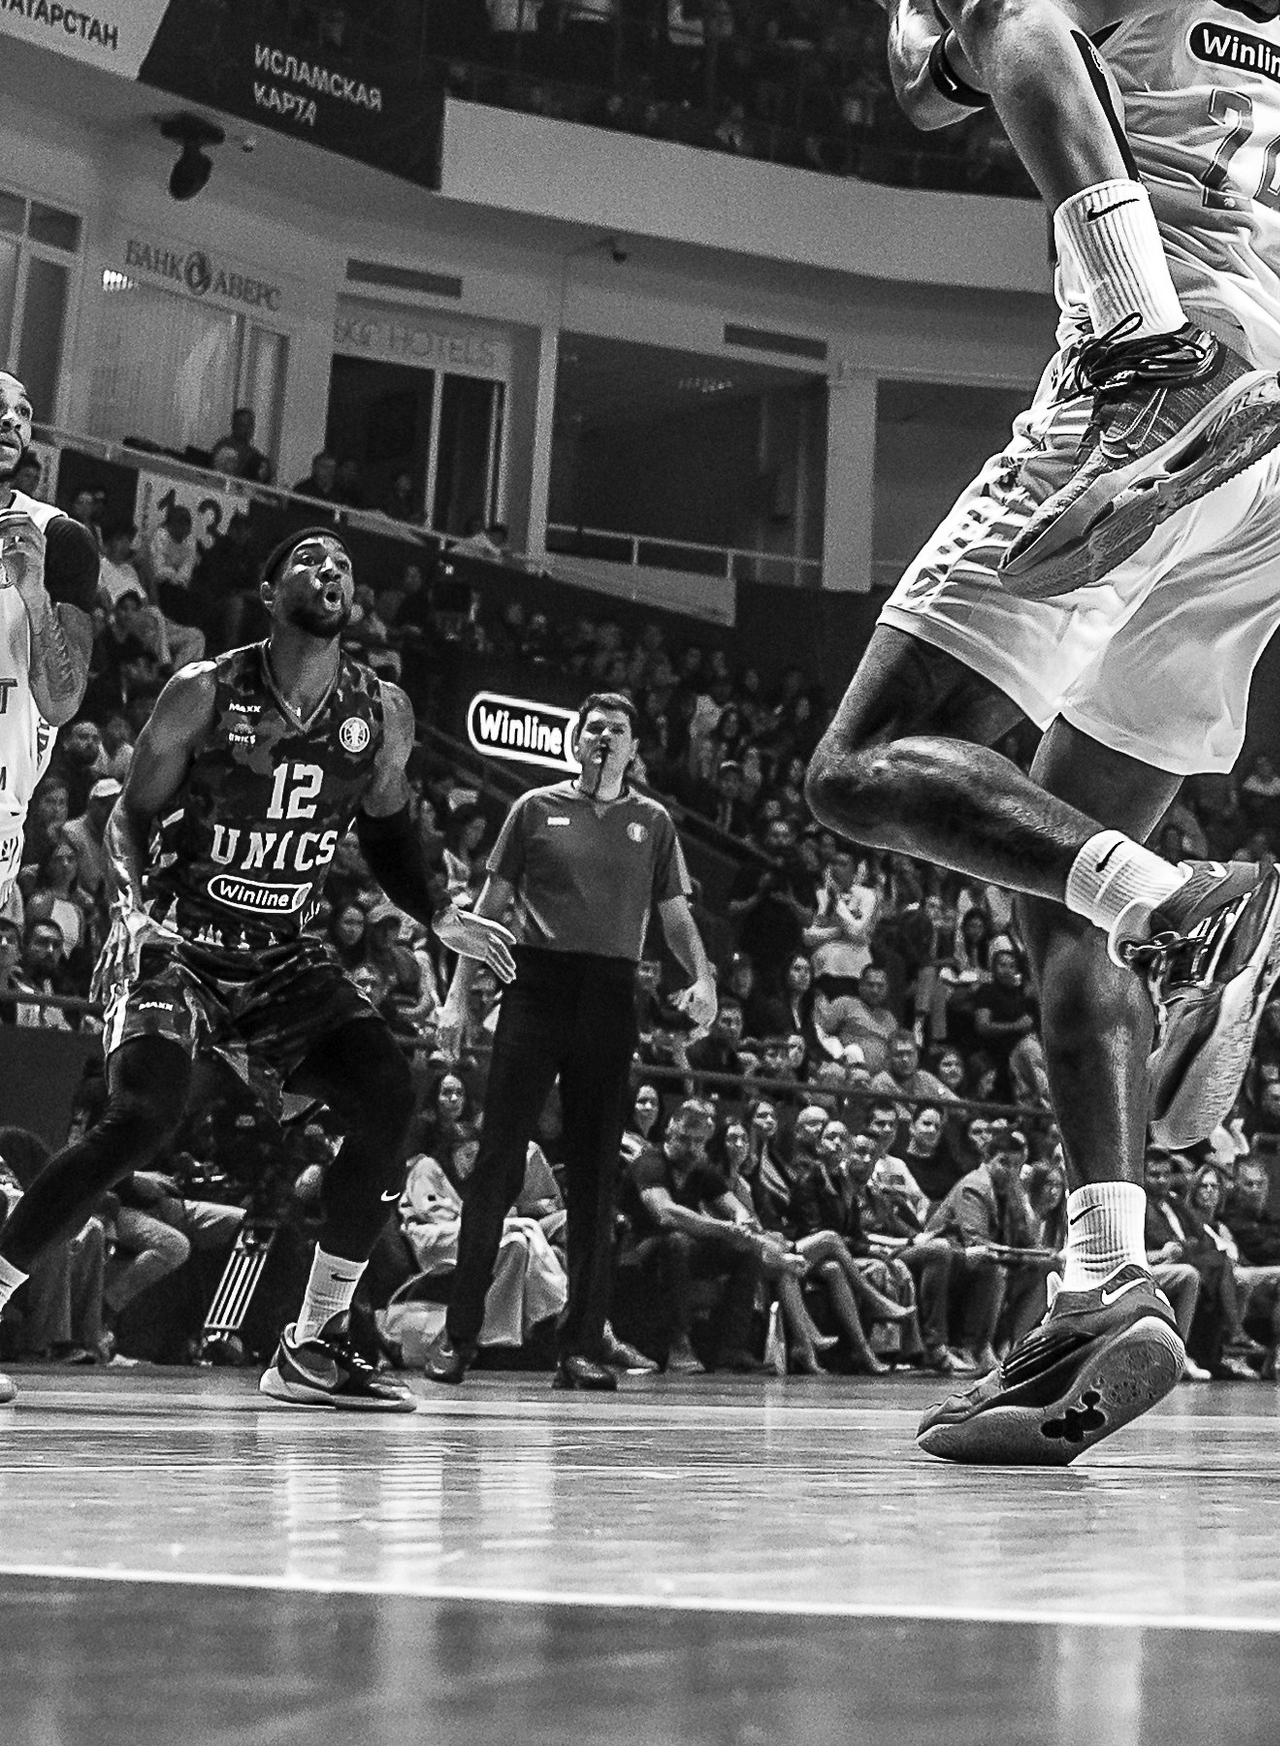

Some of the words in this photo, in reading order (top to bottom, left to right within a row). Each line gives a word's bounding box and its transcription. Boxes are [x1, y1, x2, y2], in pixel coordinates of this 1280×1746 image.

[254, 41, 384, 113] ИСЛАМСКАЯ
[252, 81, 319, 127] КАРТА
[124, 238, 184, 282] БАНК
[212, 271, 282, 311] АВЕРС
[228, 702, 262, 713] MAXX
[479, 705, 563, 756] Winline
[266, 763, 324, 820] 12
[210, 823, 339, 872] UNICS
[220, 880, 290, 907] Winline
